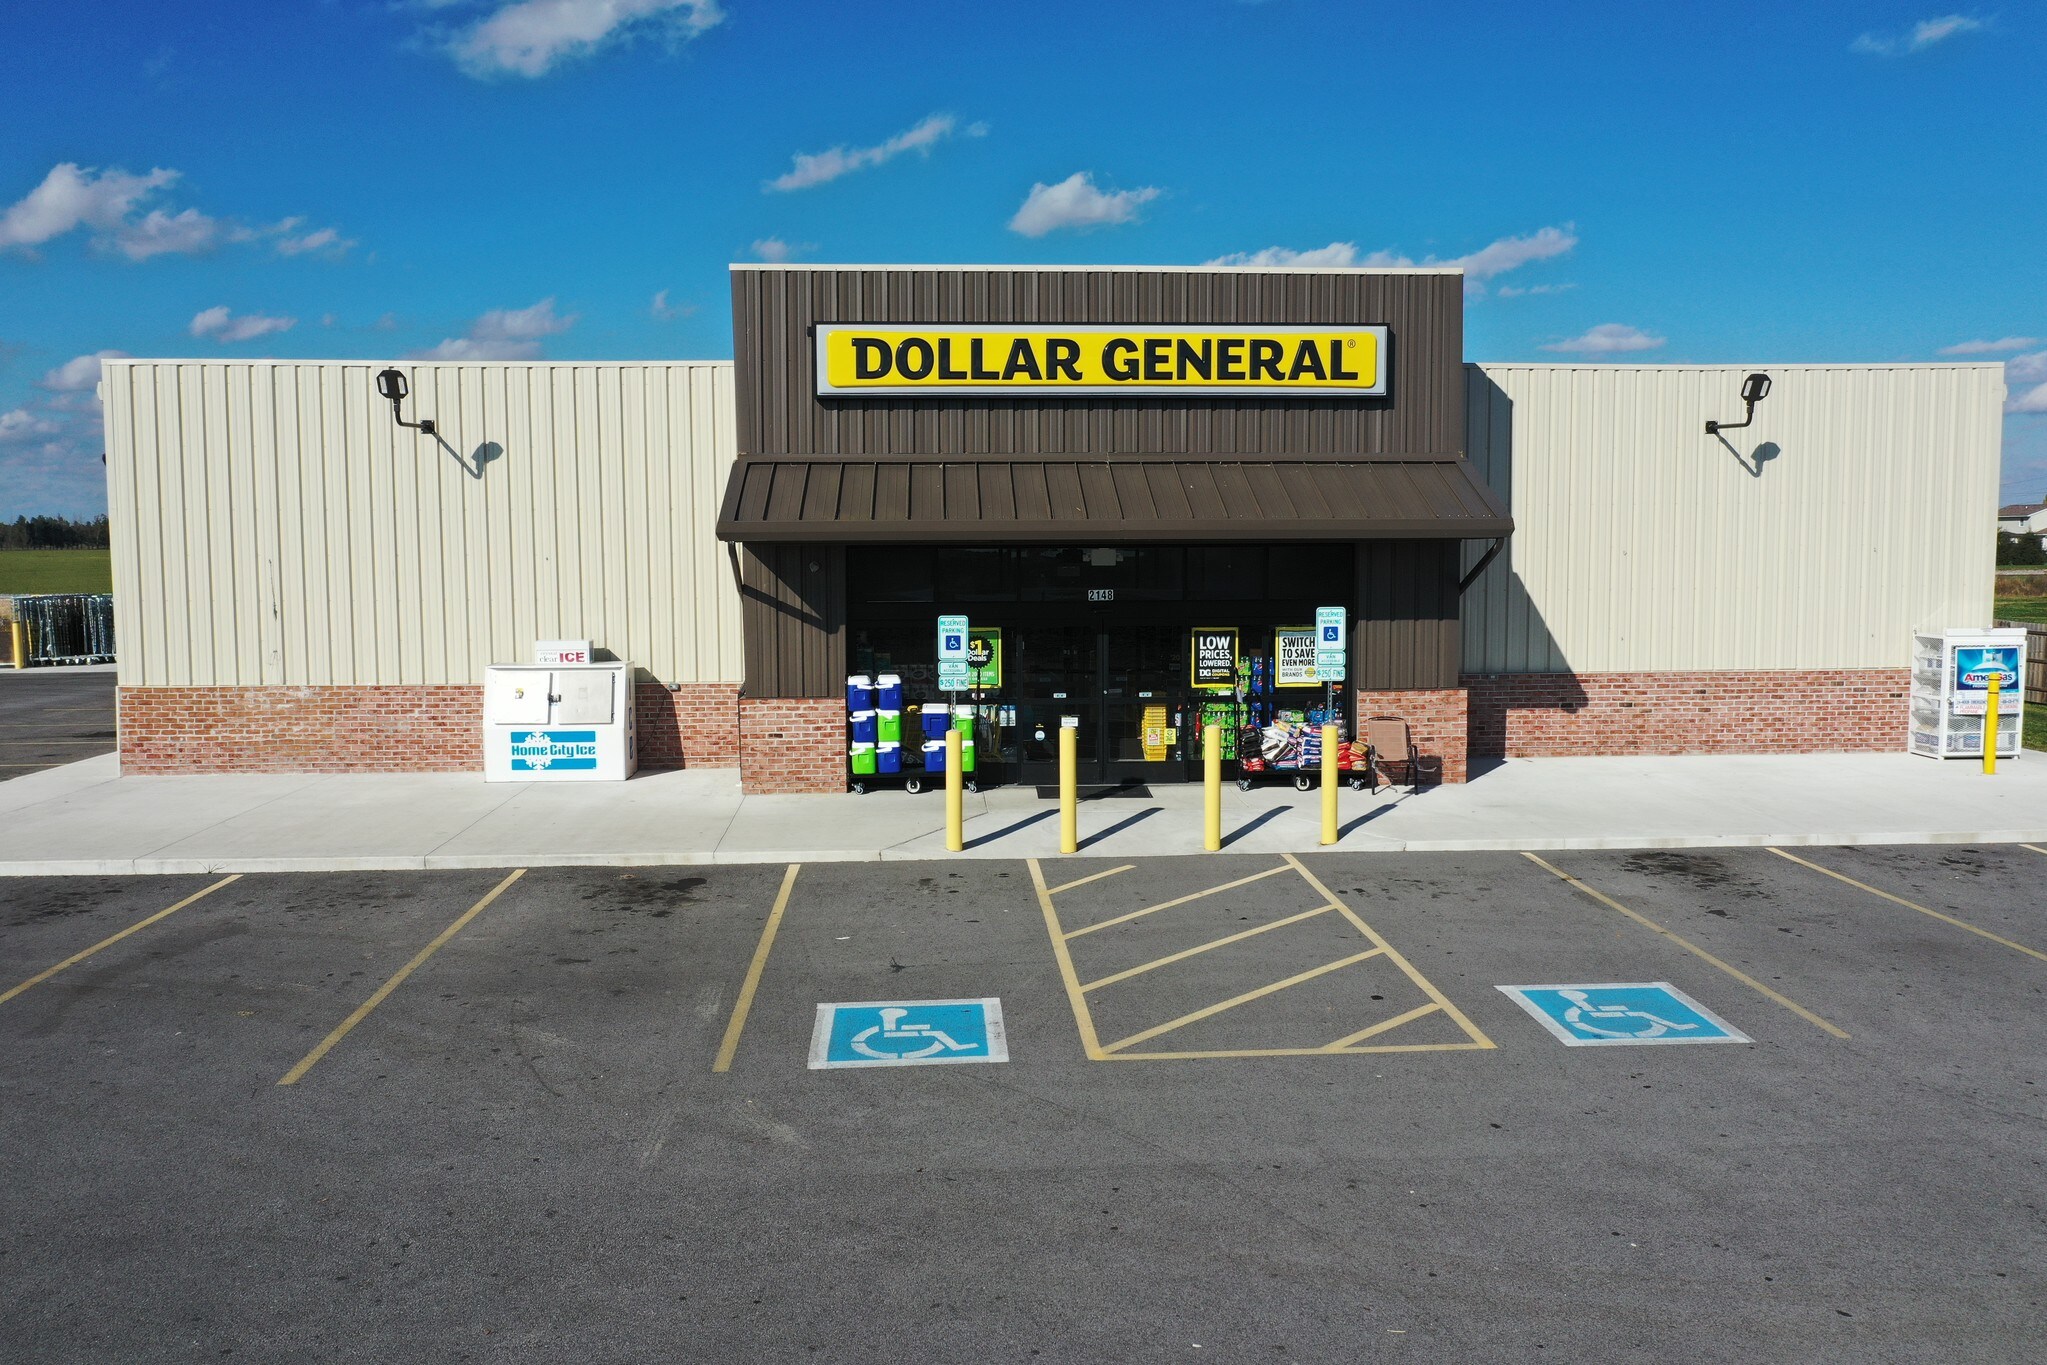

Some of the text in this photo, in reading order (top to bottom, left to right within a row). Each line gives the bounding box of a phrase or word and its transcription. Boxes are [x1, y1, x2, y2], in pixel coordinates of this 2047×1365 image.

[851, 337, 1084, 381] DOLLAR
[1089, 590, 1113, 600] 2148
[970, 640, 982, 655] $1
[1200, 636, 1230, 649] LOW
[1282, 637, 1315, 648] SWITCH
[559, 652, 585, 662] ICE
[1200, 650, 1233, 660] PRICES,
[1282, 649, 1315, 658] TO SAVE
[1199, 669, 1211, 677] DG
[1332, 669, 1344, 677] FINE
[511, 744, 596, 757] Home City Ice
